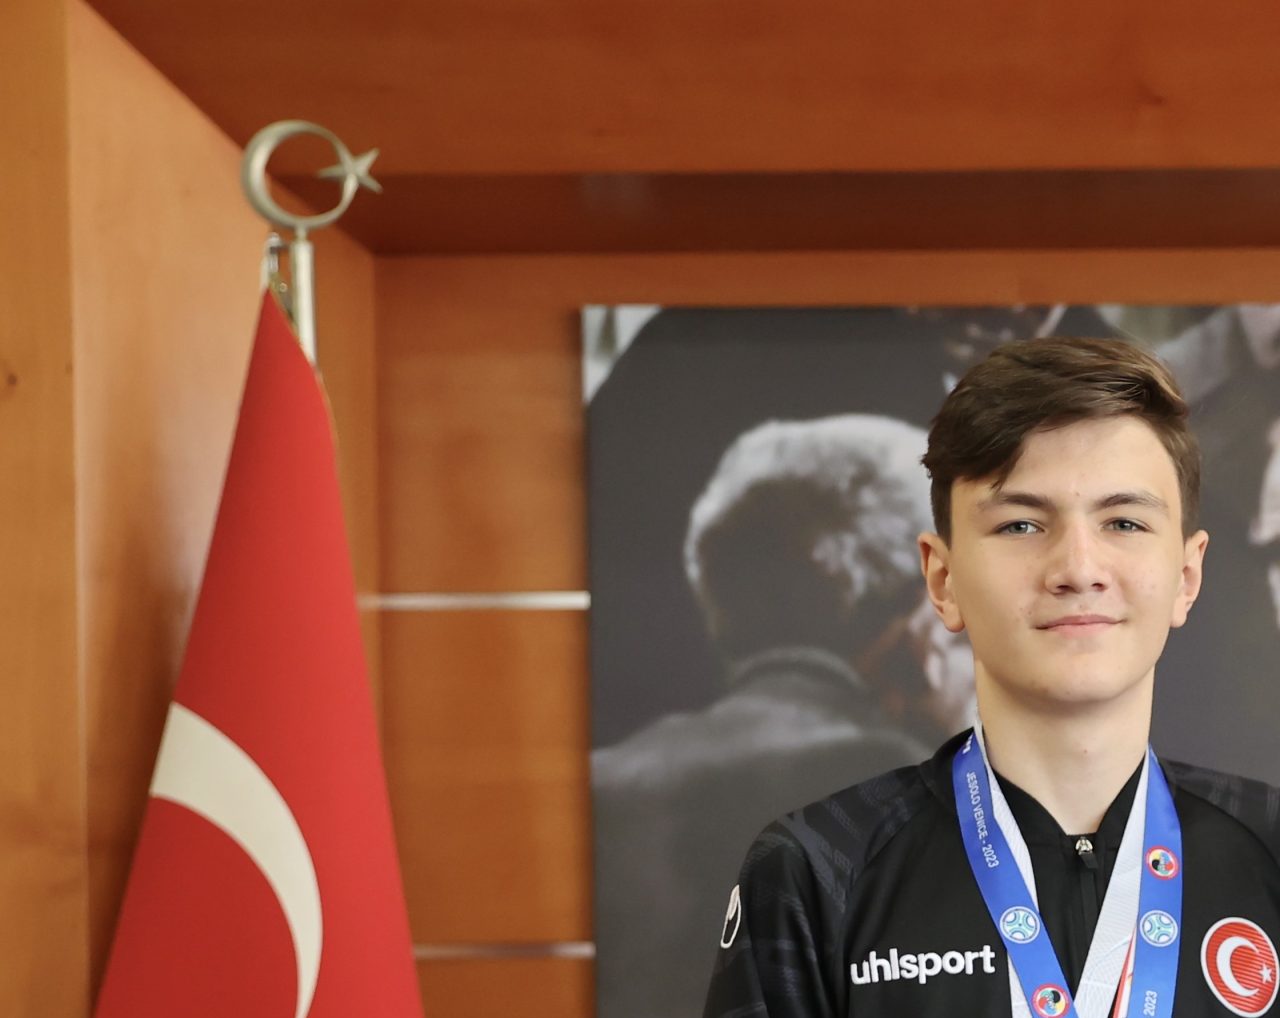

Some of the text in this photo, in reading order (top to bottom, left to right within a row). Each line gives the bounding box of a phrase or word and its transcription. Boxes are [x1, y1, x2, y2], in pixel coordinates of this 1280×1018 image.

[966, 772, 980, 804] JESOLO
[972, 803, 988, 840] VENICE
[982, 843, 999, 868] 2023
[850, 945, 996, 984] uhlsport
[1143, 990, 1157, 1016] 2023
